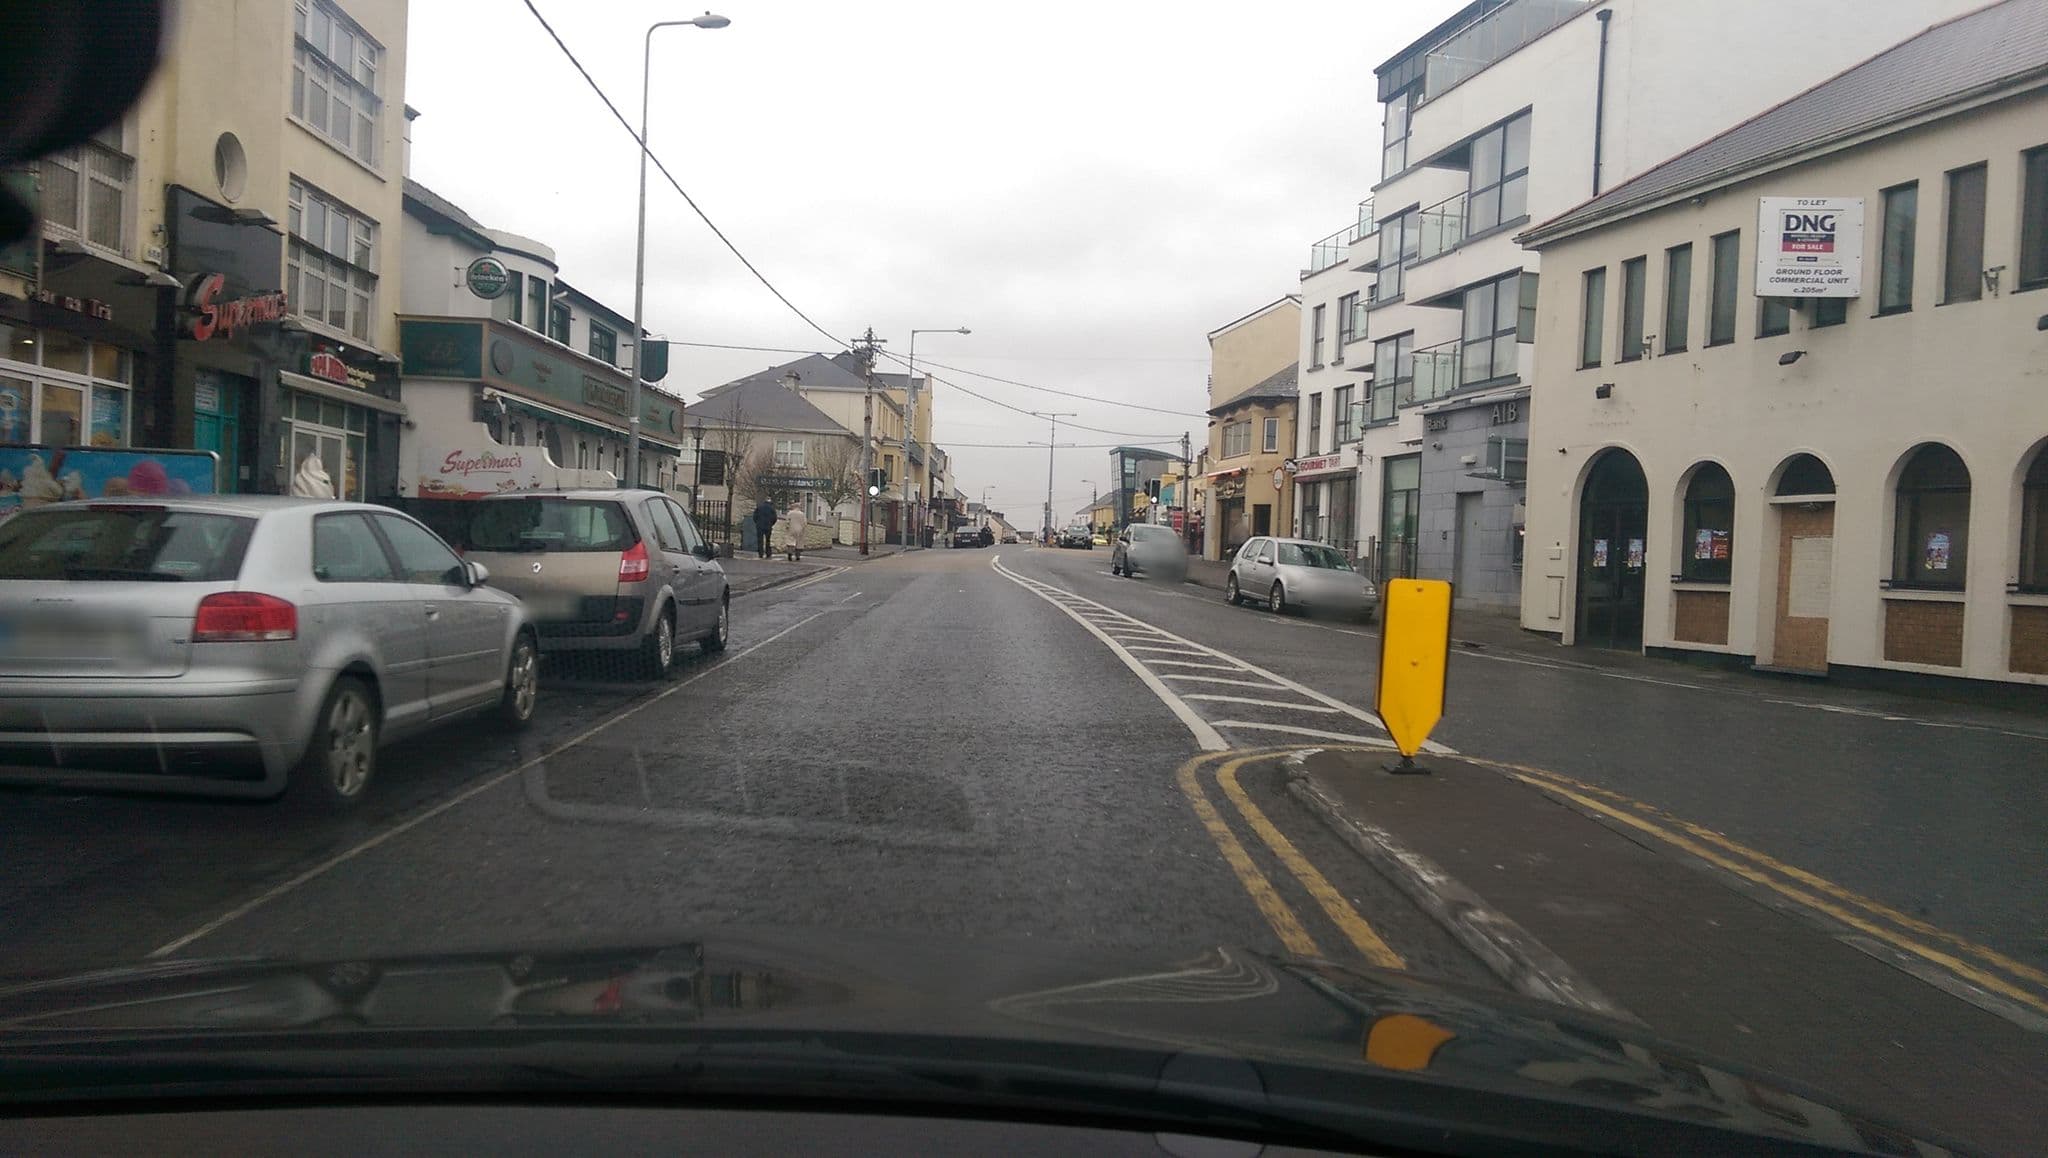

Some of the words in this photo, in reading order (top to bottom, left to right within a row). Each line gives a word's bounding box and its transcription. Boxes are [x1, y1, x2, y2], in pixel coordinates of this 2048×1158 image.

[1785, 214, 1836, 232] DNG
[1776, 268, 1812, 276] GROUND
[1492, 402, 1517, 424] AIB
[440, 450, 522, 477] Supermac's
[1300, 459, 1327, 471] GOURMET
